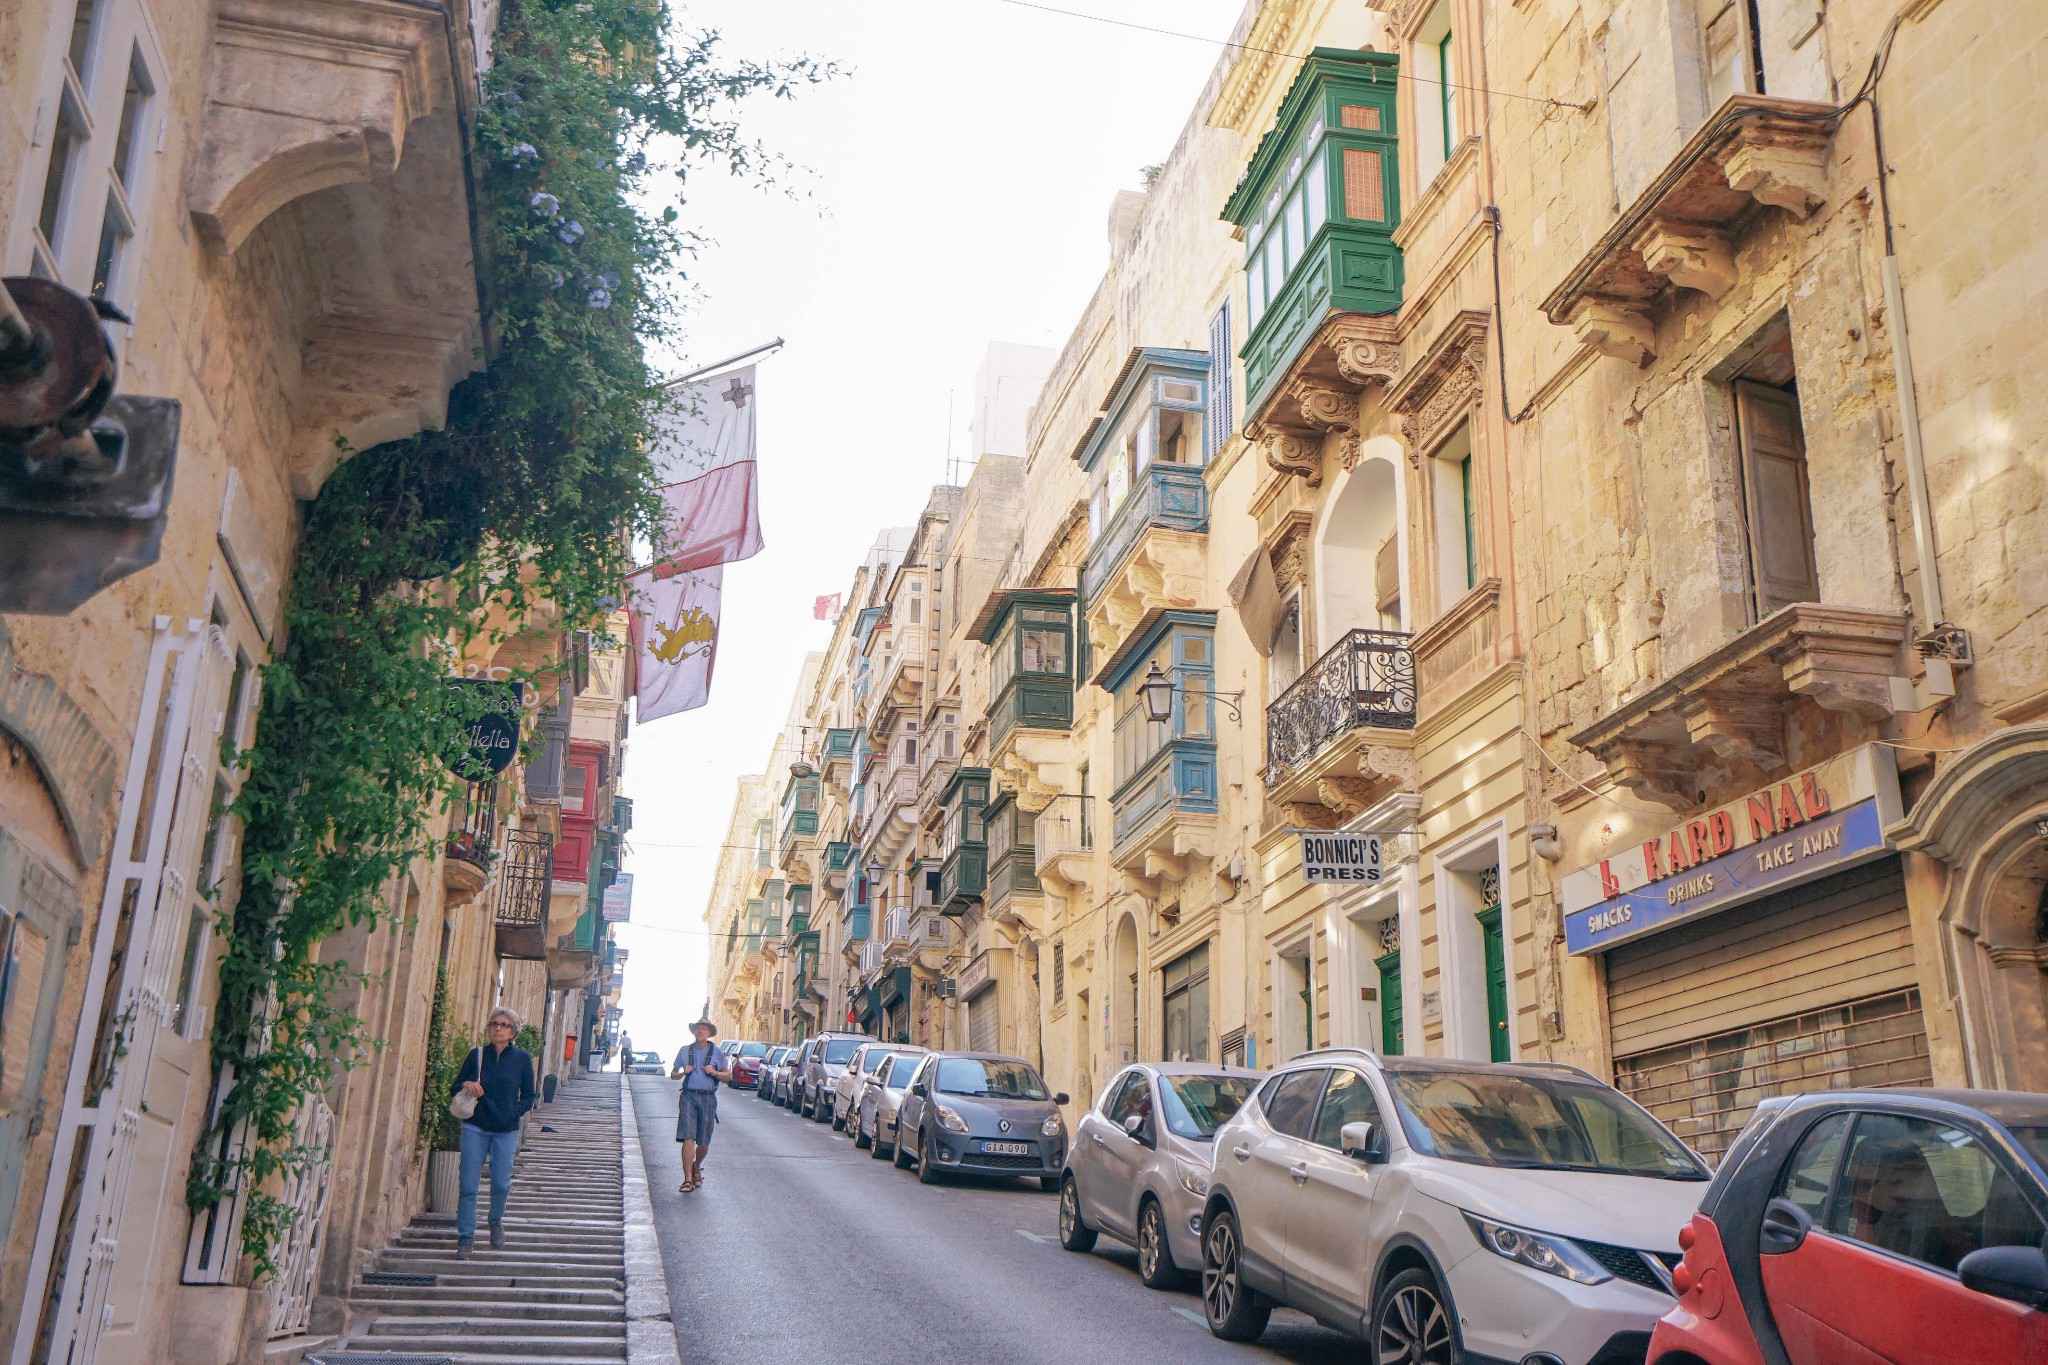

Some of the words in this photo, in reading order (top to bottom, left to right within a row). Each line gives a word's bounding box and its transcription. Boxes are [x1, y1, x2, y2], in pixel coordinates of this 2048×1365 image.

[1304, 838, 1379, 864] BONNICI'S
[1307, 867, 1380, 880] PRESS
[1588, 904, 1632, 933] SNACKS
[1668, 873, 1713, 905] DRINKS
[1757, 842, 1794, 872] TAKE
[1803, 824, 1841, 857] AWAY
